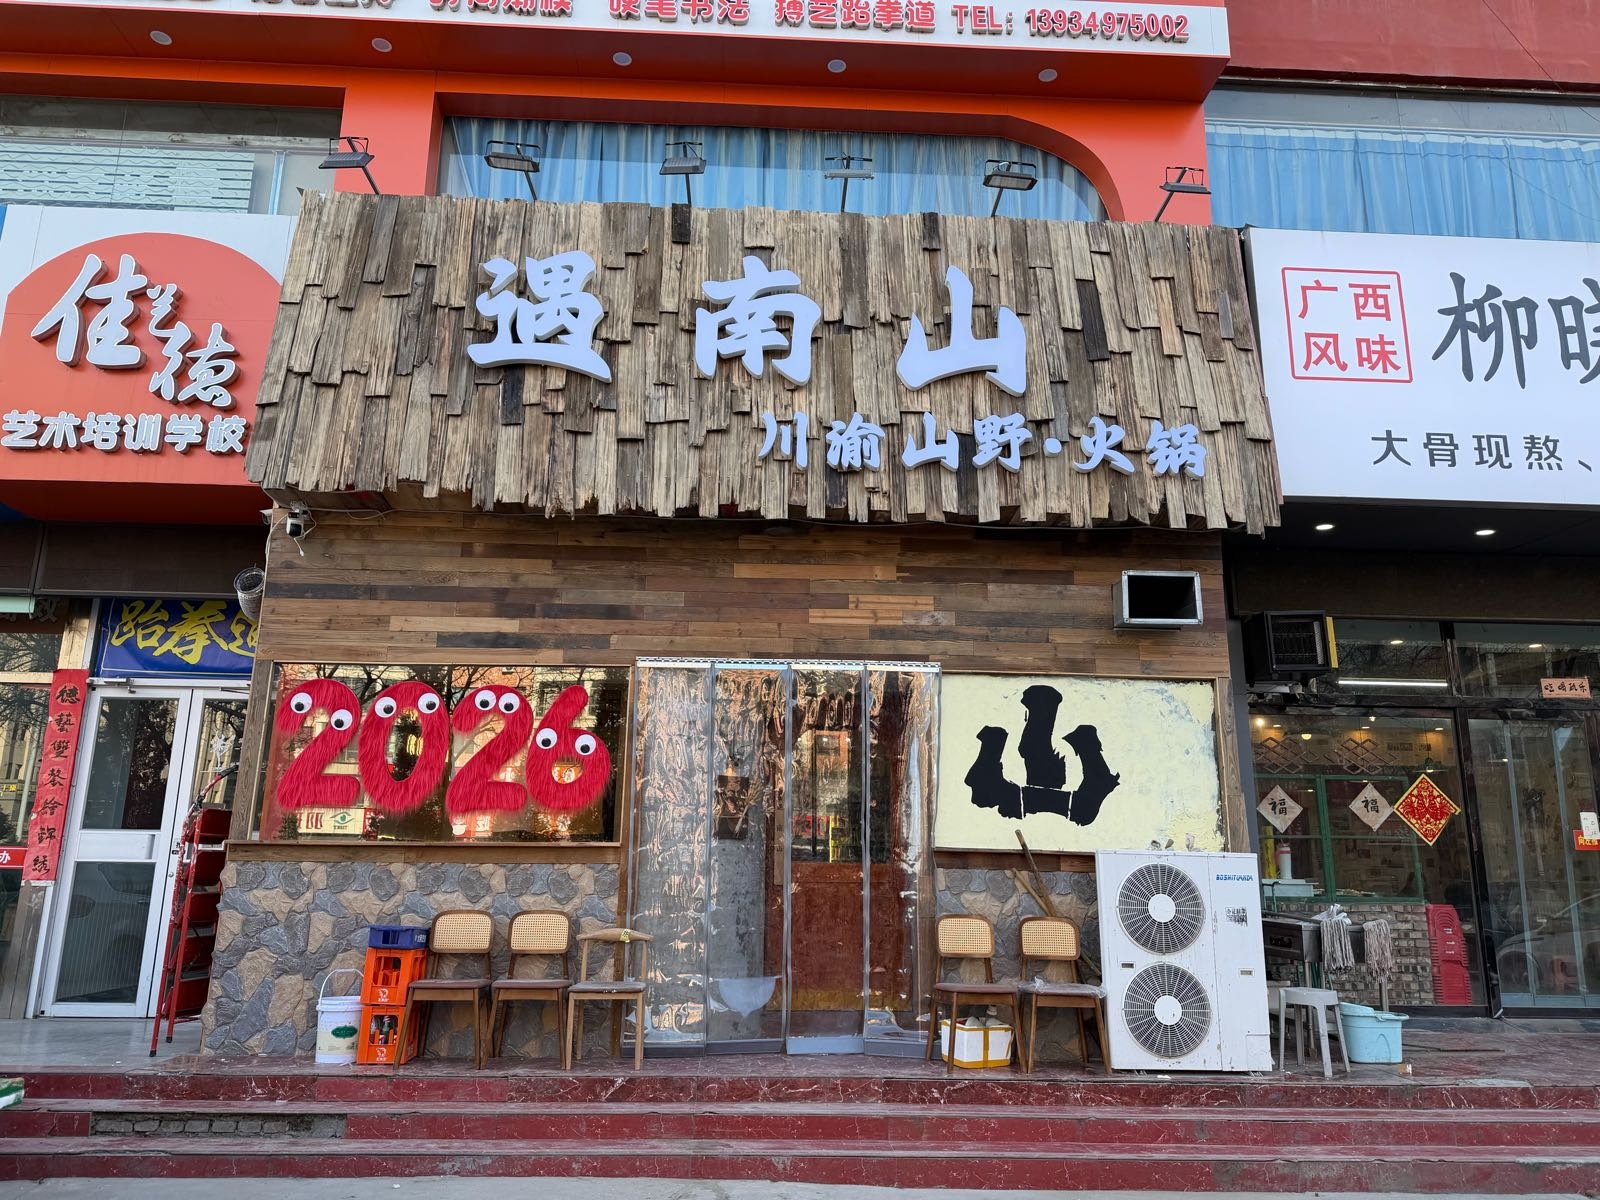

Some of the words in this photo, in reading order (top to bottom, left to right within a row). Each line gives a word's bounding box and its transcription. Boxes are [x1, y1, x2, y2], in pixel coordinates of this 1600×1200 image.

[1026, 8, 1189, 41] 13934975002
[1298, 279, 1392, 322] 广西
[467, 250, 1027, 397] 遇南山
[1302, 331, 1402, 374] 风味
[1, 409, 247, 452] 艺术培训学校
[758, 411, 1207, 477] 川渝山野·火锅
[1371, 429, 1593, 473] 大骨现熬、
[276, 678, 612, 816] 2026
[1268, 797, 1288, 816] 福
[1361, 795, 1380, 814] 福
